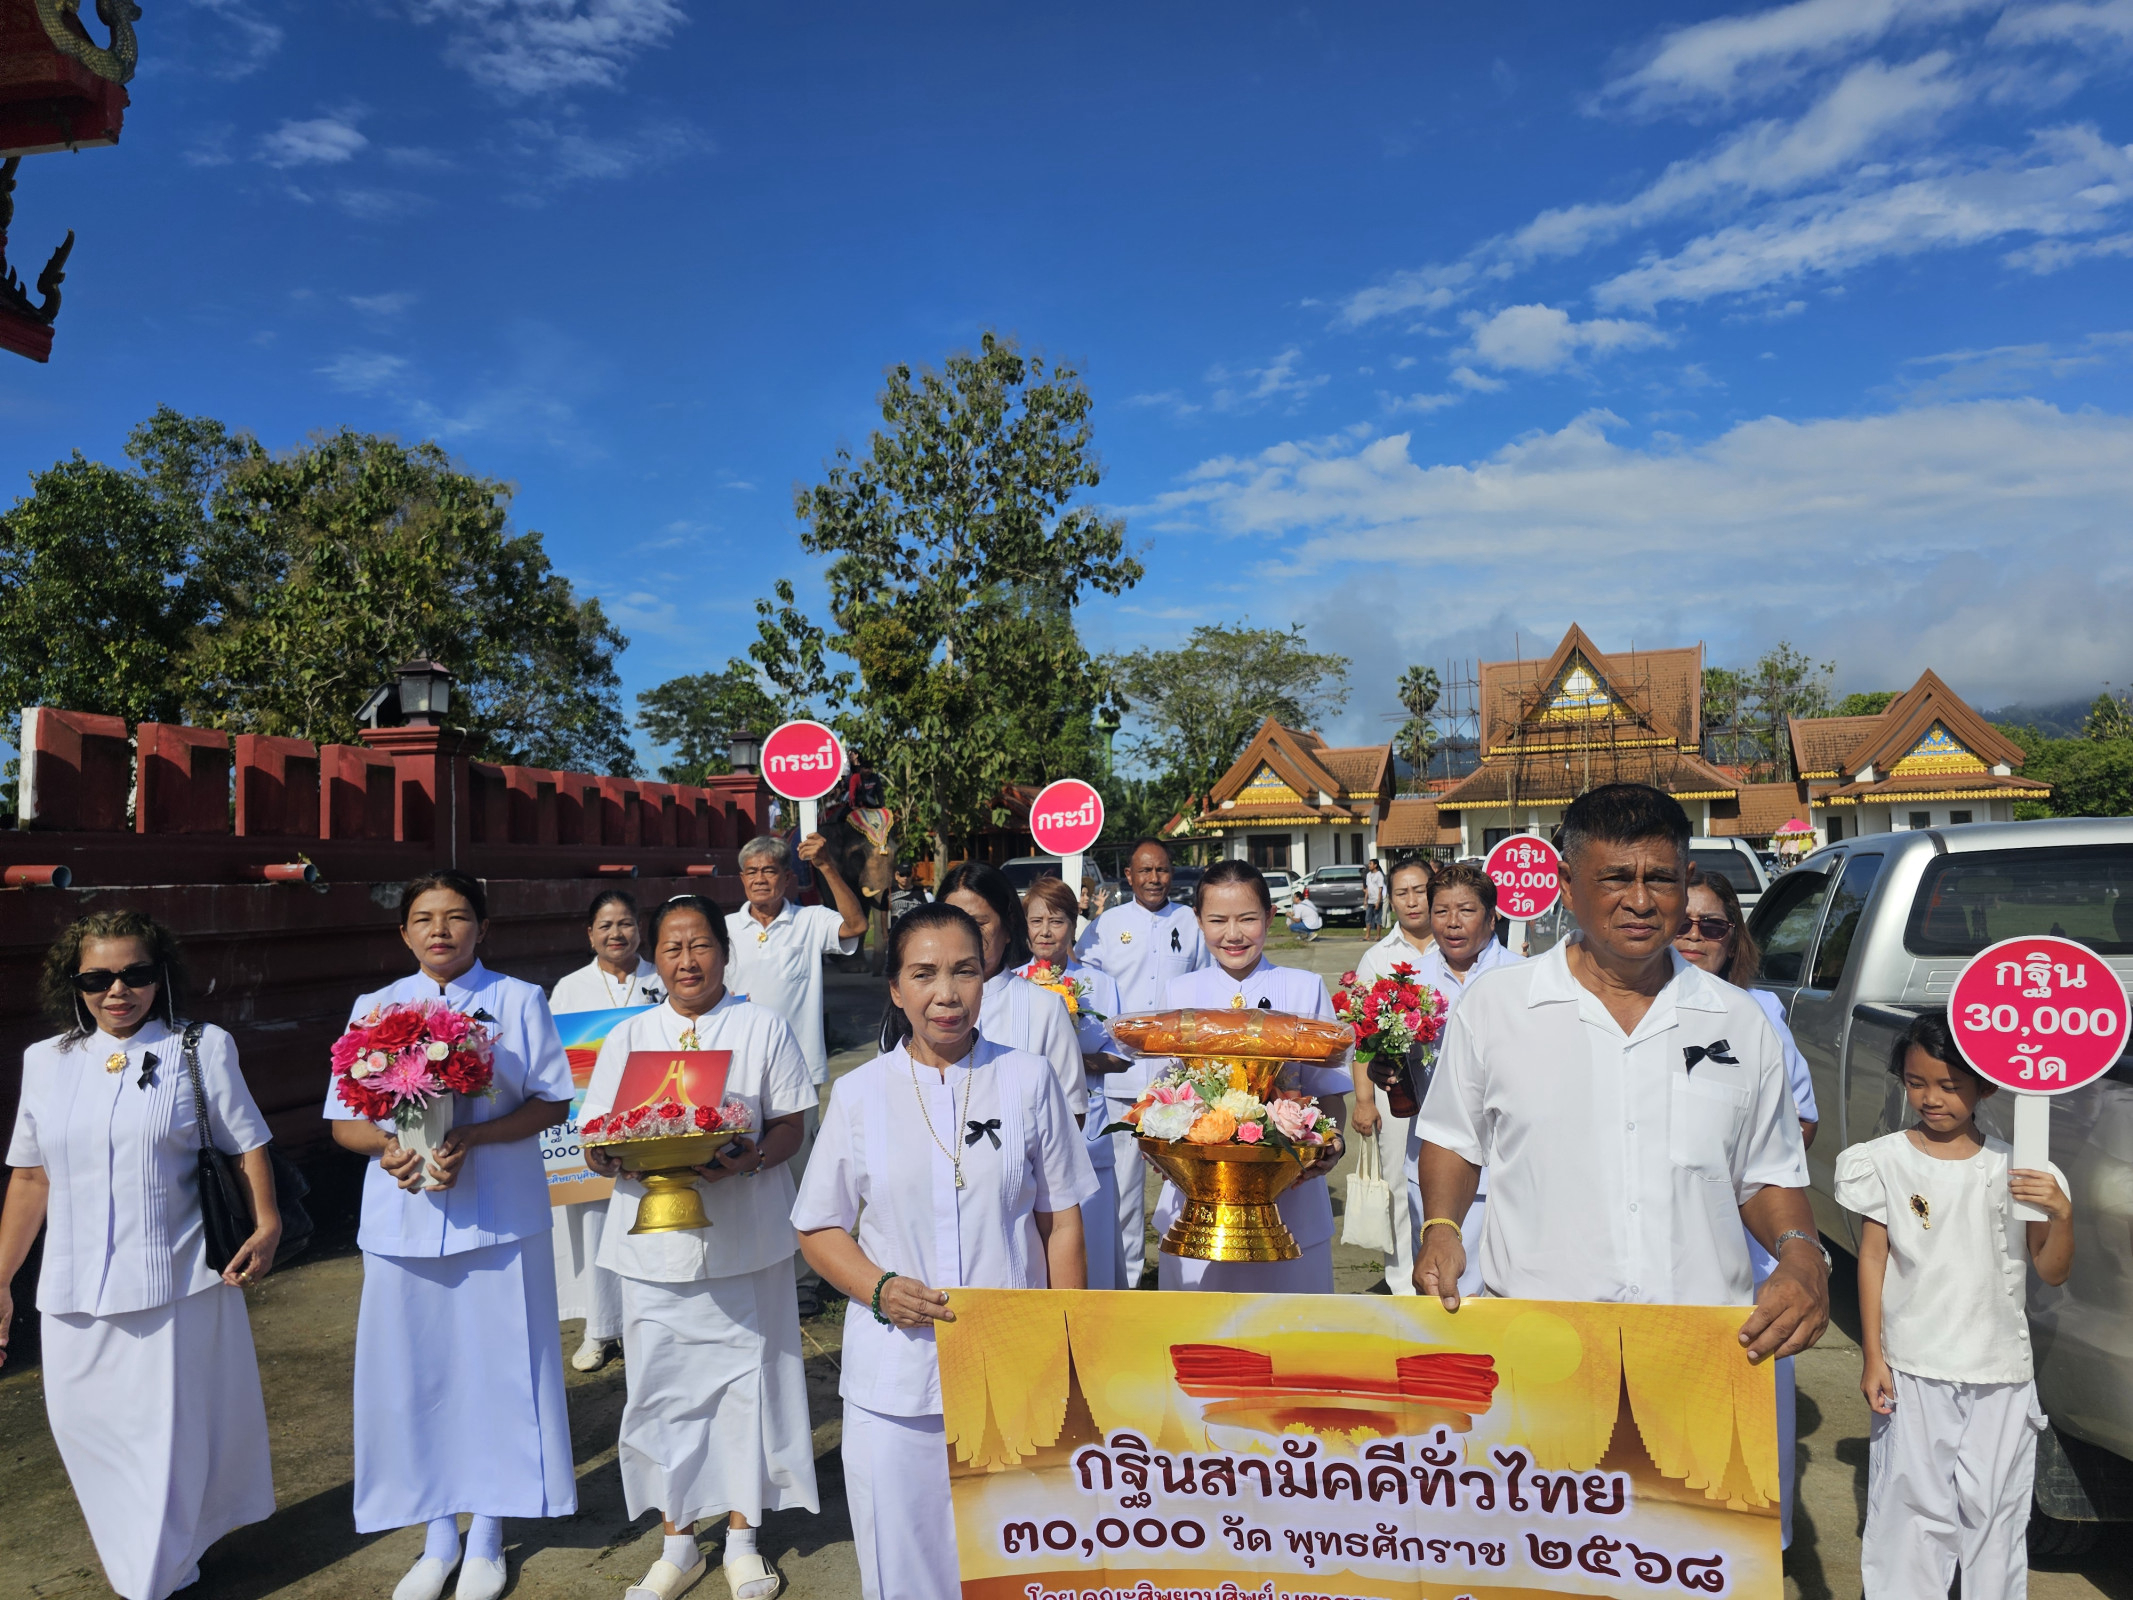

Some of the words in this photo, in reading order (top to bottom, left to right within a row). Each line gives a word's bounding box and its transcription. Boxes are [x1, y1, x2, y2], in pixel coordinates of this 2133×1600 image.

[770, 739, 833, 773] กระบี่
[1037, 796, 1095, 830] กระบี่
[1505, 843, 1547, 869] กฐิน
[1491, 870, 1558, 889] 30,000
[1508, 892, 1535, 913] วัด
[1995, 952, 2088, 999] กฐิน
[1963, 1003, 2117, 1037] 30,000
[2007, 1043, 2067, 1082] วัด
[1076, 1430, 1625, 1515] กฐินสามัคคีทั่วไทย
[1003, 1518, 1206, 1557] ๓๐,๐๐๐
[1222, 1515, 1272, 1552] วัด
[1284, 1522, 1506, 1569] พุทธศักราช
[1525, 1533, 1724, 1593] ๒๕๖๘
